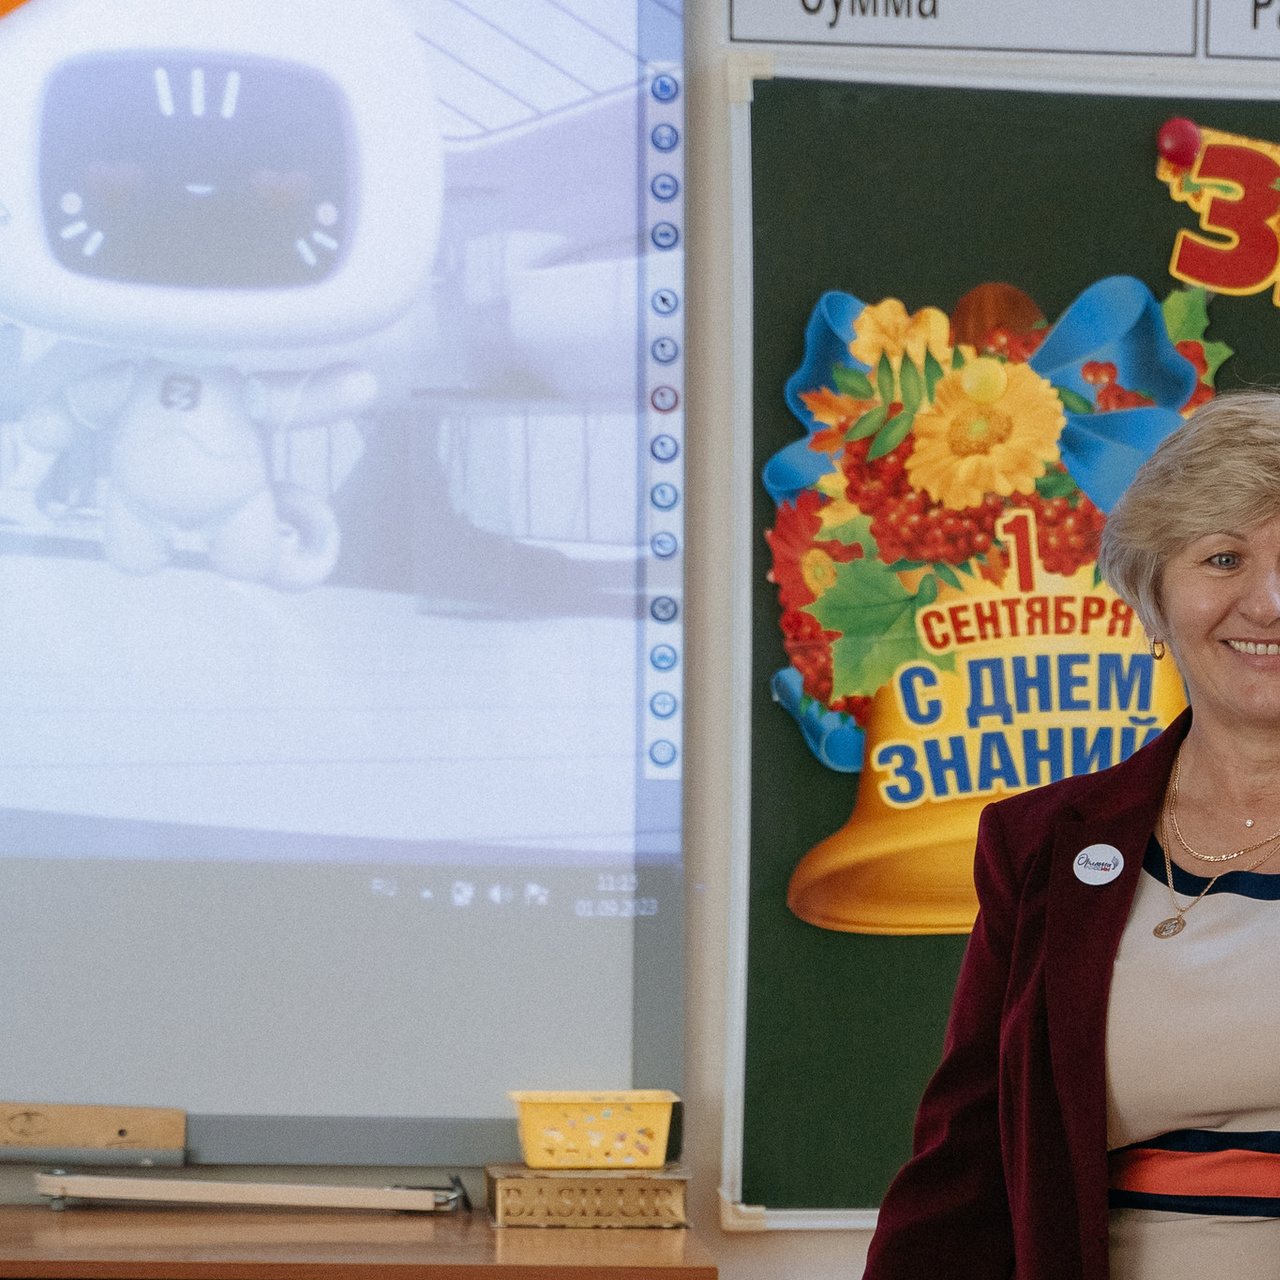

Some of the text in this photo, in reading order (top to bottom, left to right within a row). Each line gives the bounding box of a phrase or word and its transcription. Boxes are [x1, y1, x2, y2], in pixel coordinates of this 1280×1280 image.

[1002, 514, 1034, 592] 1
[921, 596, 1134, 649] СЕНТЯБРЯ
[899, 653, 1154, 728] С ДНЕМ
[504, 1187, 680, 1218] BASILUR
